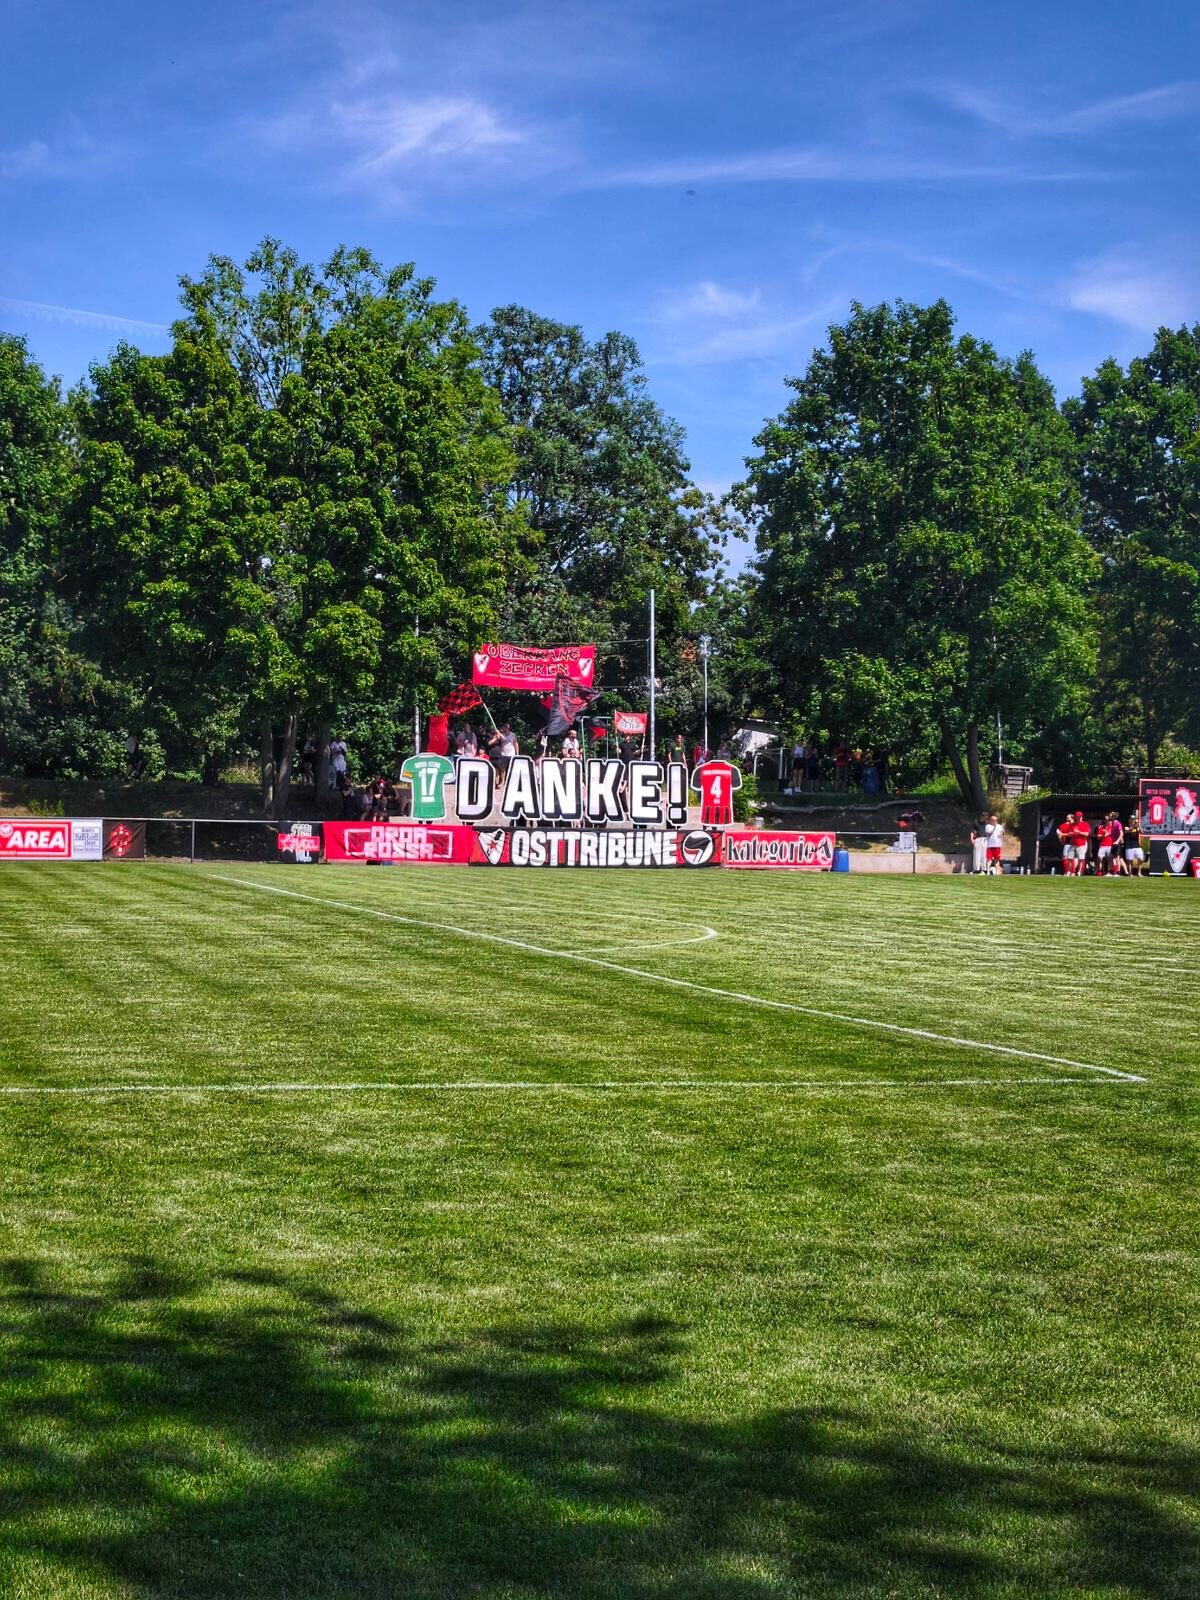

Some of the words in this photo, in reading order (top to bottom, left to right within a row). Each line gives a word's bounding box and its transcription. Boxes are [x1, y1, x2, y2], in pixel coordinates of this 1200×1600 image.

[418, 767, 439, 796] 17
[456, 755, 689, 826] DANKE!
[710, 776, 722, 799] 4
[6, 830, 66, 849] AREA
[363, 841, 434, 860] ROSSA
